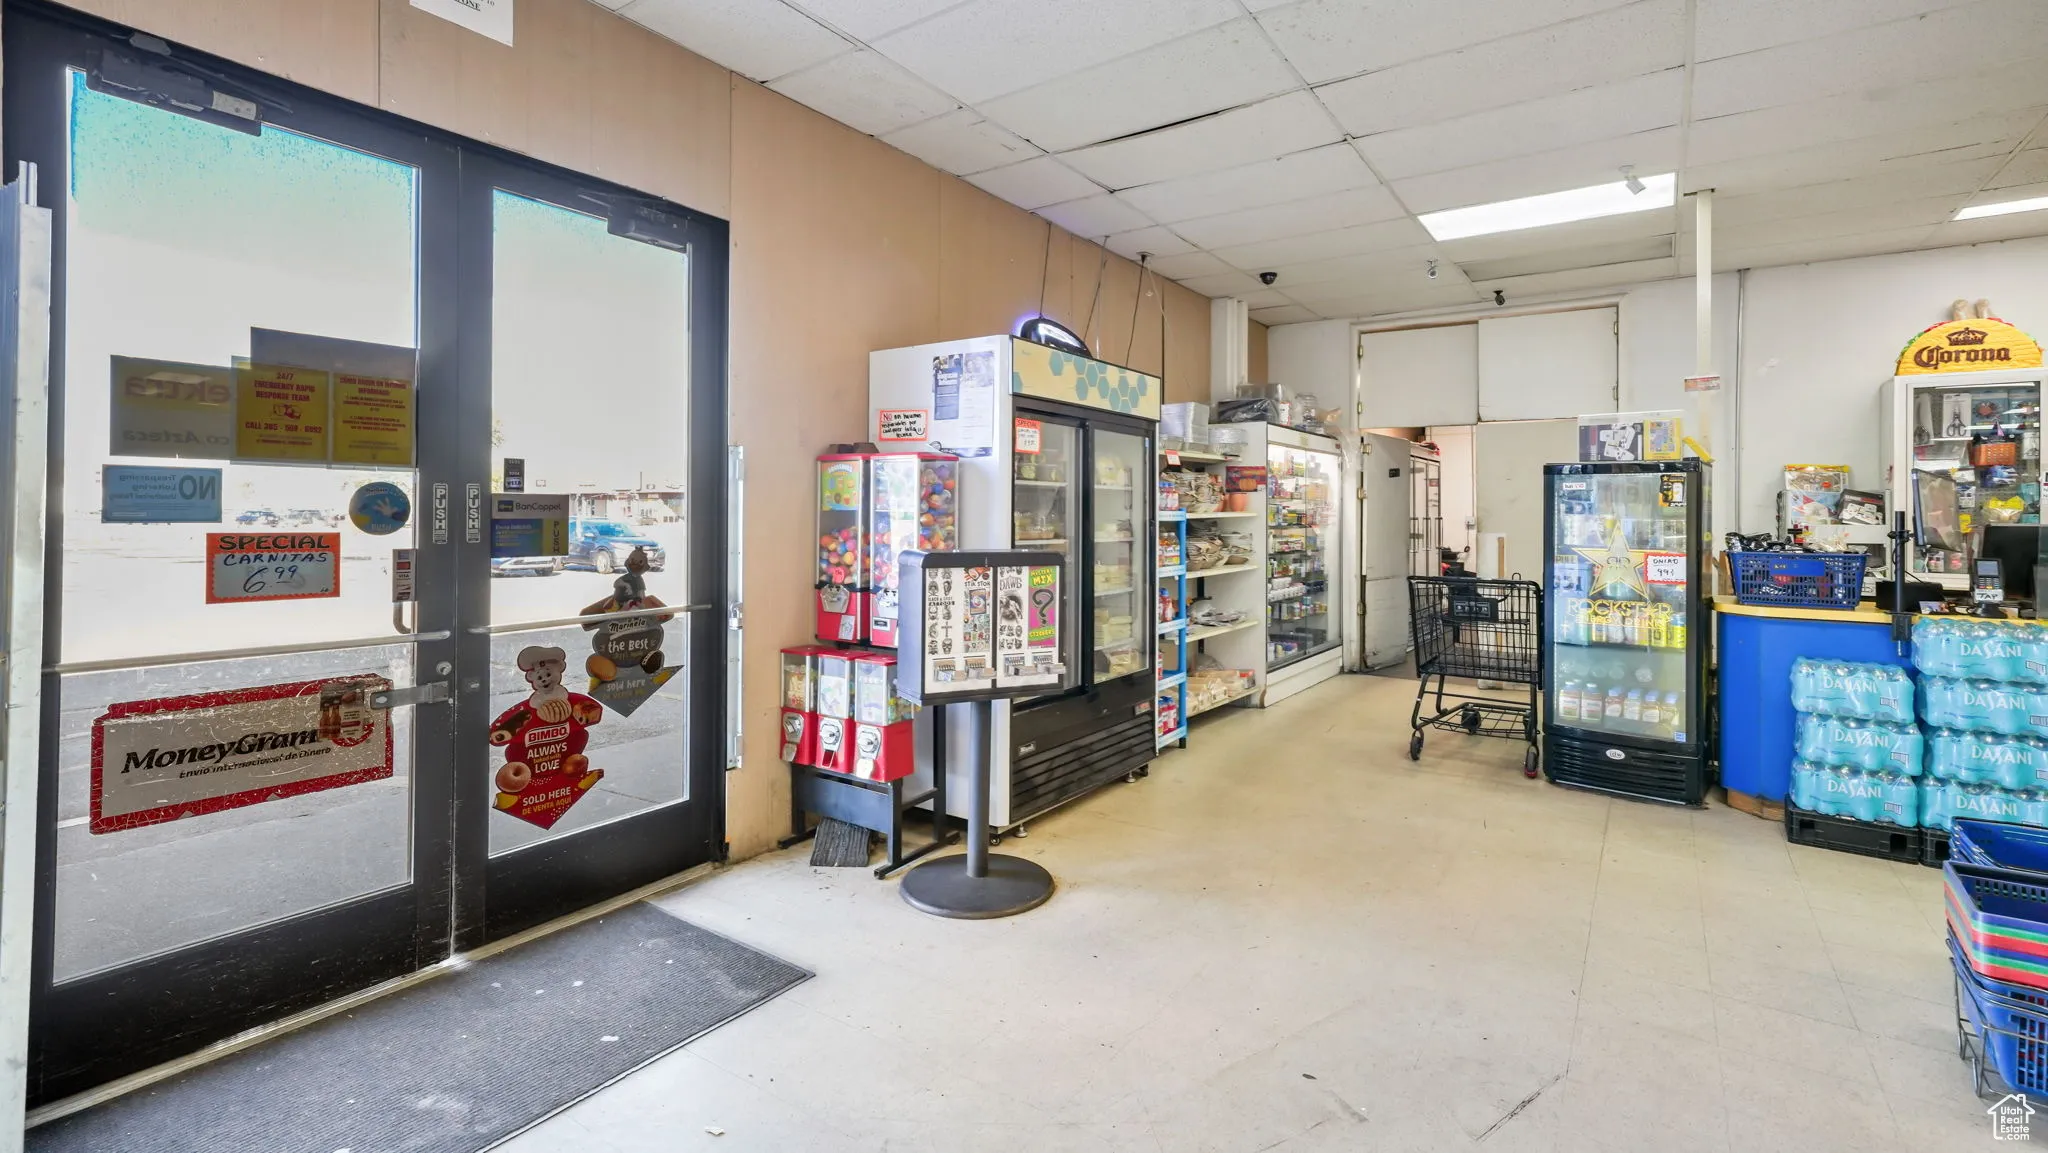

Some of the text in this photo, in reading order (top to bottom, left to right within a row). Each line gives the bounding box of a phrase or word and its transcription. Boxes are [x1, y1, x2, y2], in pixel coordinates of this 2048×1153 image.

[1914, 345, 2012, 370] Corona
[245, 422, 261, 430] CALL
[435, 488, 446, 530] PUSH
[468, 488, 479, 529] PUSH
[515, 501, 561, 512] BanCoppel
[219, 535, 330, 551] SPECIAL
[552, 520, 560, 554] PUSH
[223, 552, 328, 567] CARNITAS
[1033, 575, 1053, 586] MIX
[1567, 597, 1673, 621] ROCKSTAR
[608, 618, 646, 632] Marinela
[608, 640, 625, 653] the
[1960, 641, 2022, 659] DASANI
[1823, 675, 1878, 693] DASANI
[1963, 690, 2026, 711] DASANI
[528, 727, 567, 743] BIMBO
[1835, 730, 1889, 748] DASANI
[120, 729, 320, 774] MoneyGram
[527, 742, 568, 760] ALWAYS
[533, 755, 550, 764] baked
[1971, 745, 2032, 765] DASANI
[535, 759, 560, 774] LOVE
[522, 786, 571, 807] SOLD HERE
[1828, 779, 1882, 798] DASANI
[522, 807, 533, 816] DE
[533, 801, 555, 813] VENTA
[1956, 794, 2018, 816] DASANI
